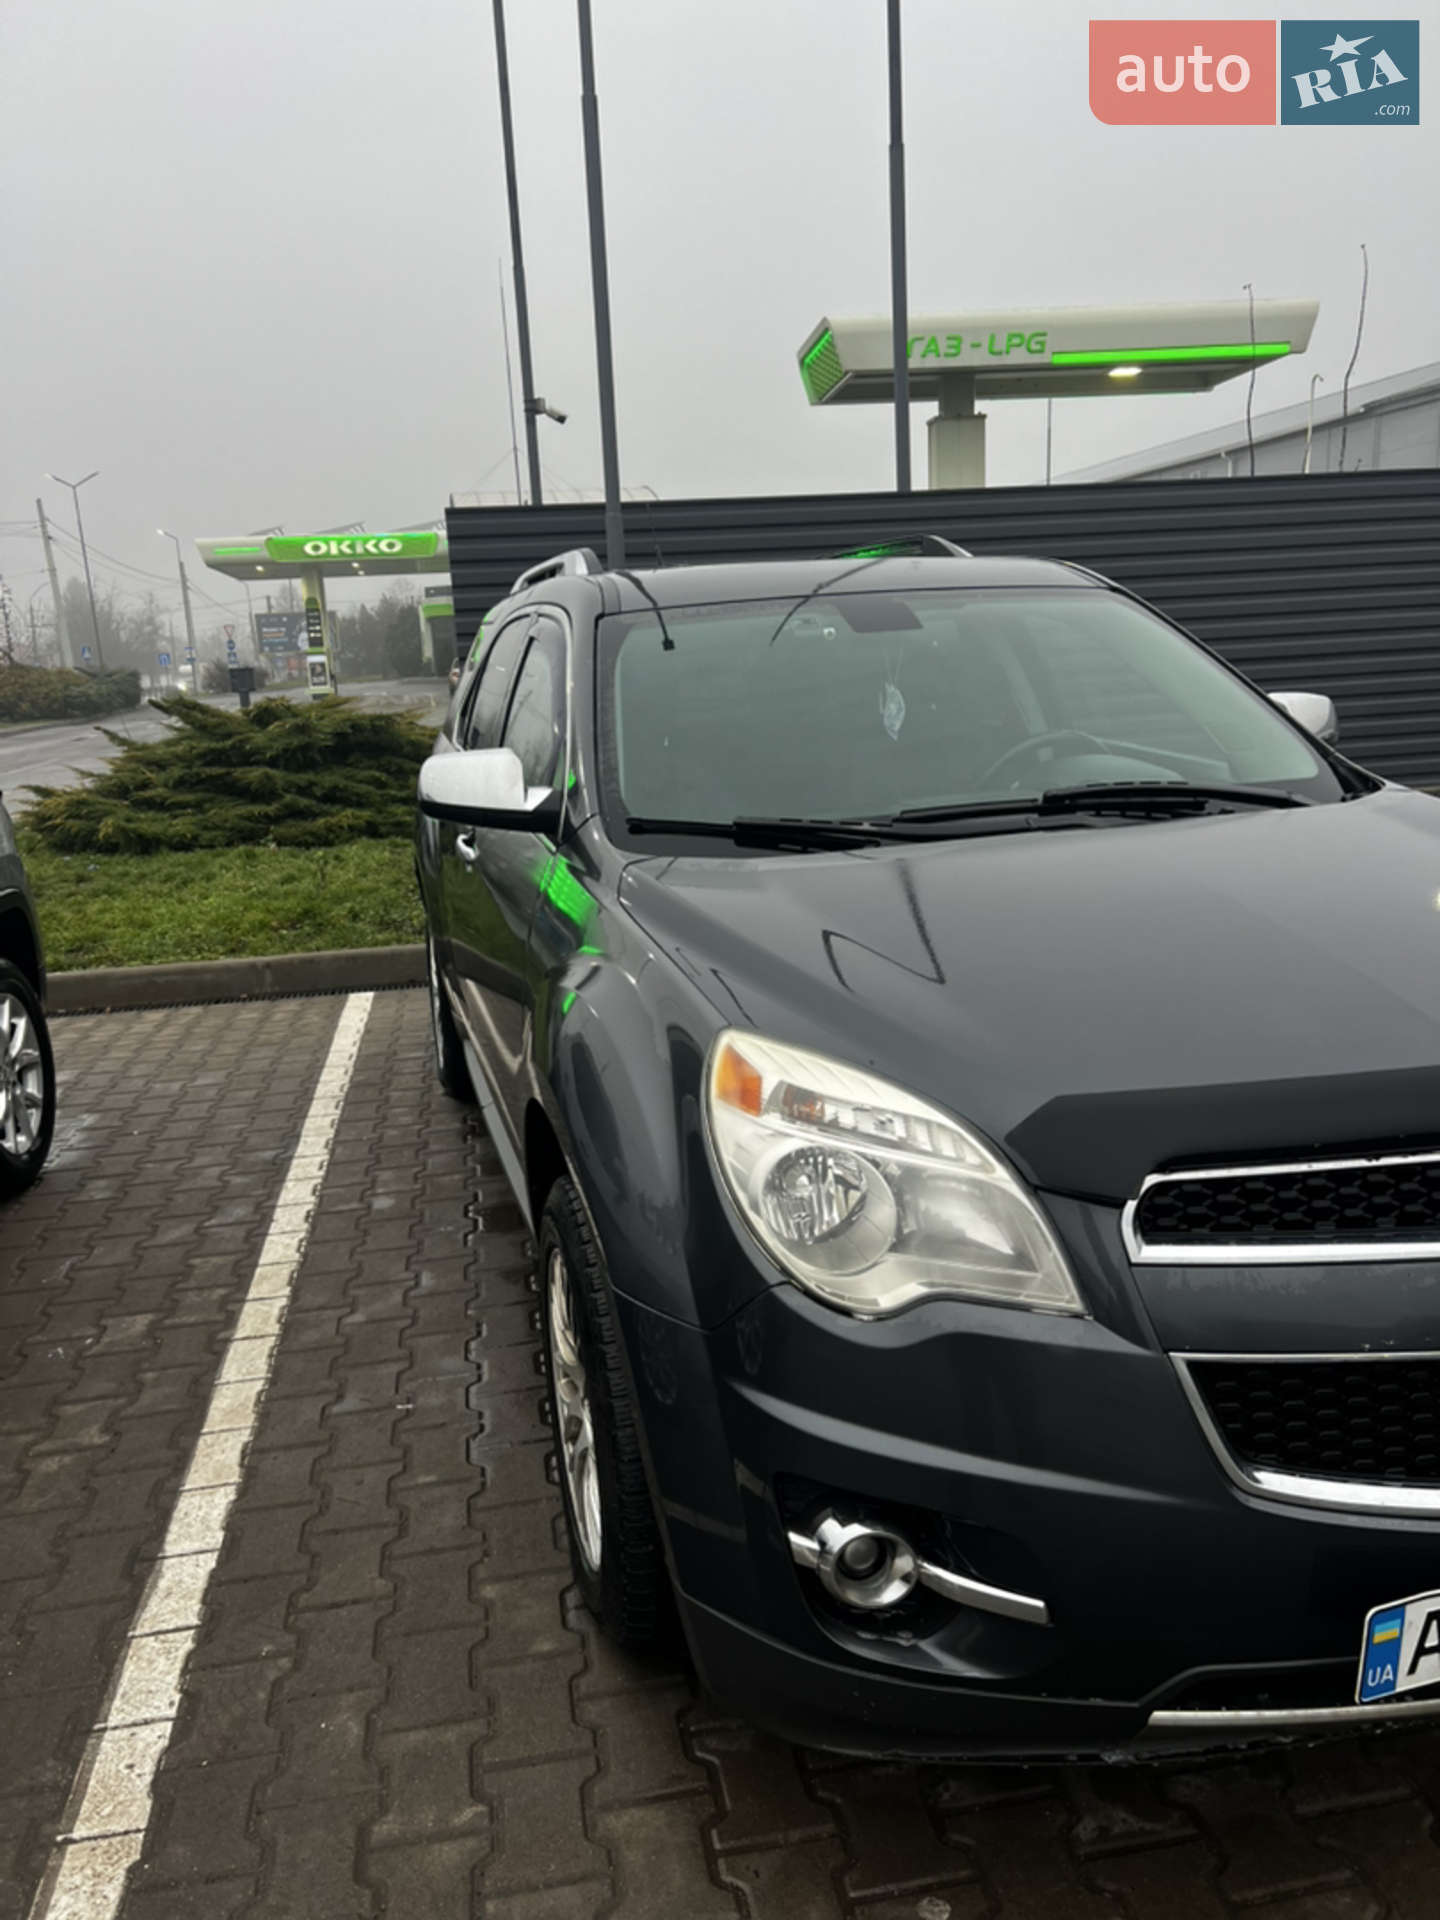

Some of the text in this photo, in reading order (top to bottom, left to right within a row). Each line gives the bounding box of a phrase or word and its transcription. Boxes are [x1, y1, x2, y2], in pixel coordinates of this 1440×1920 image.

[988, 331, 1047, 355] LPG
[303, 538, 402, 556] OKKO
[1367, 1663, 1394, 1687] UA
